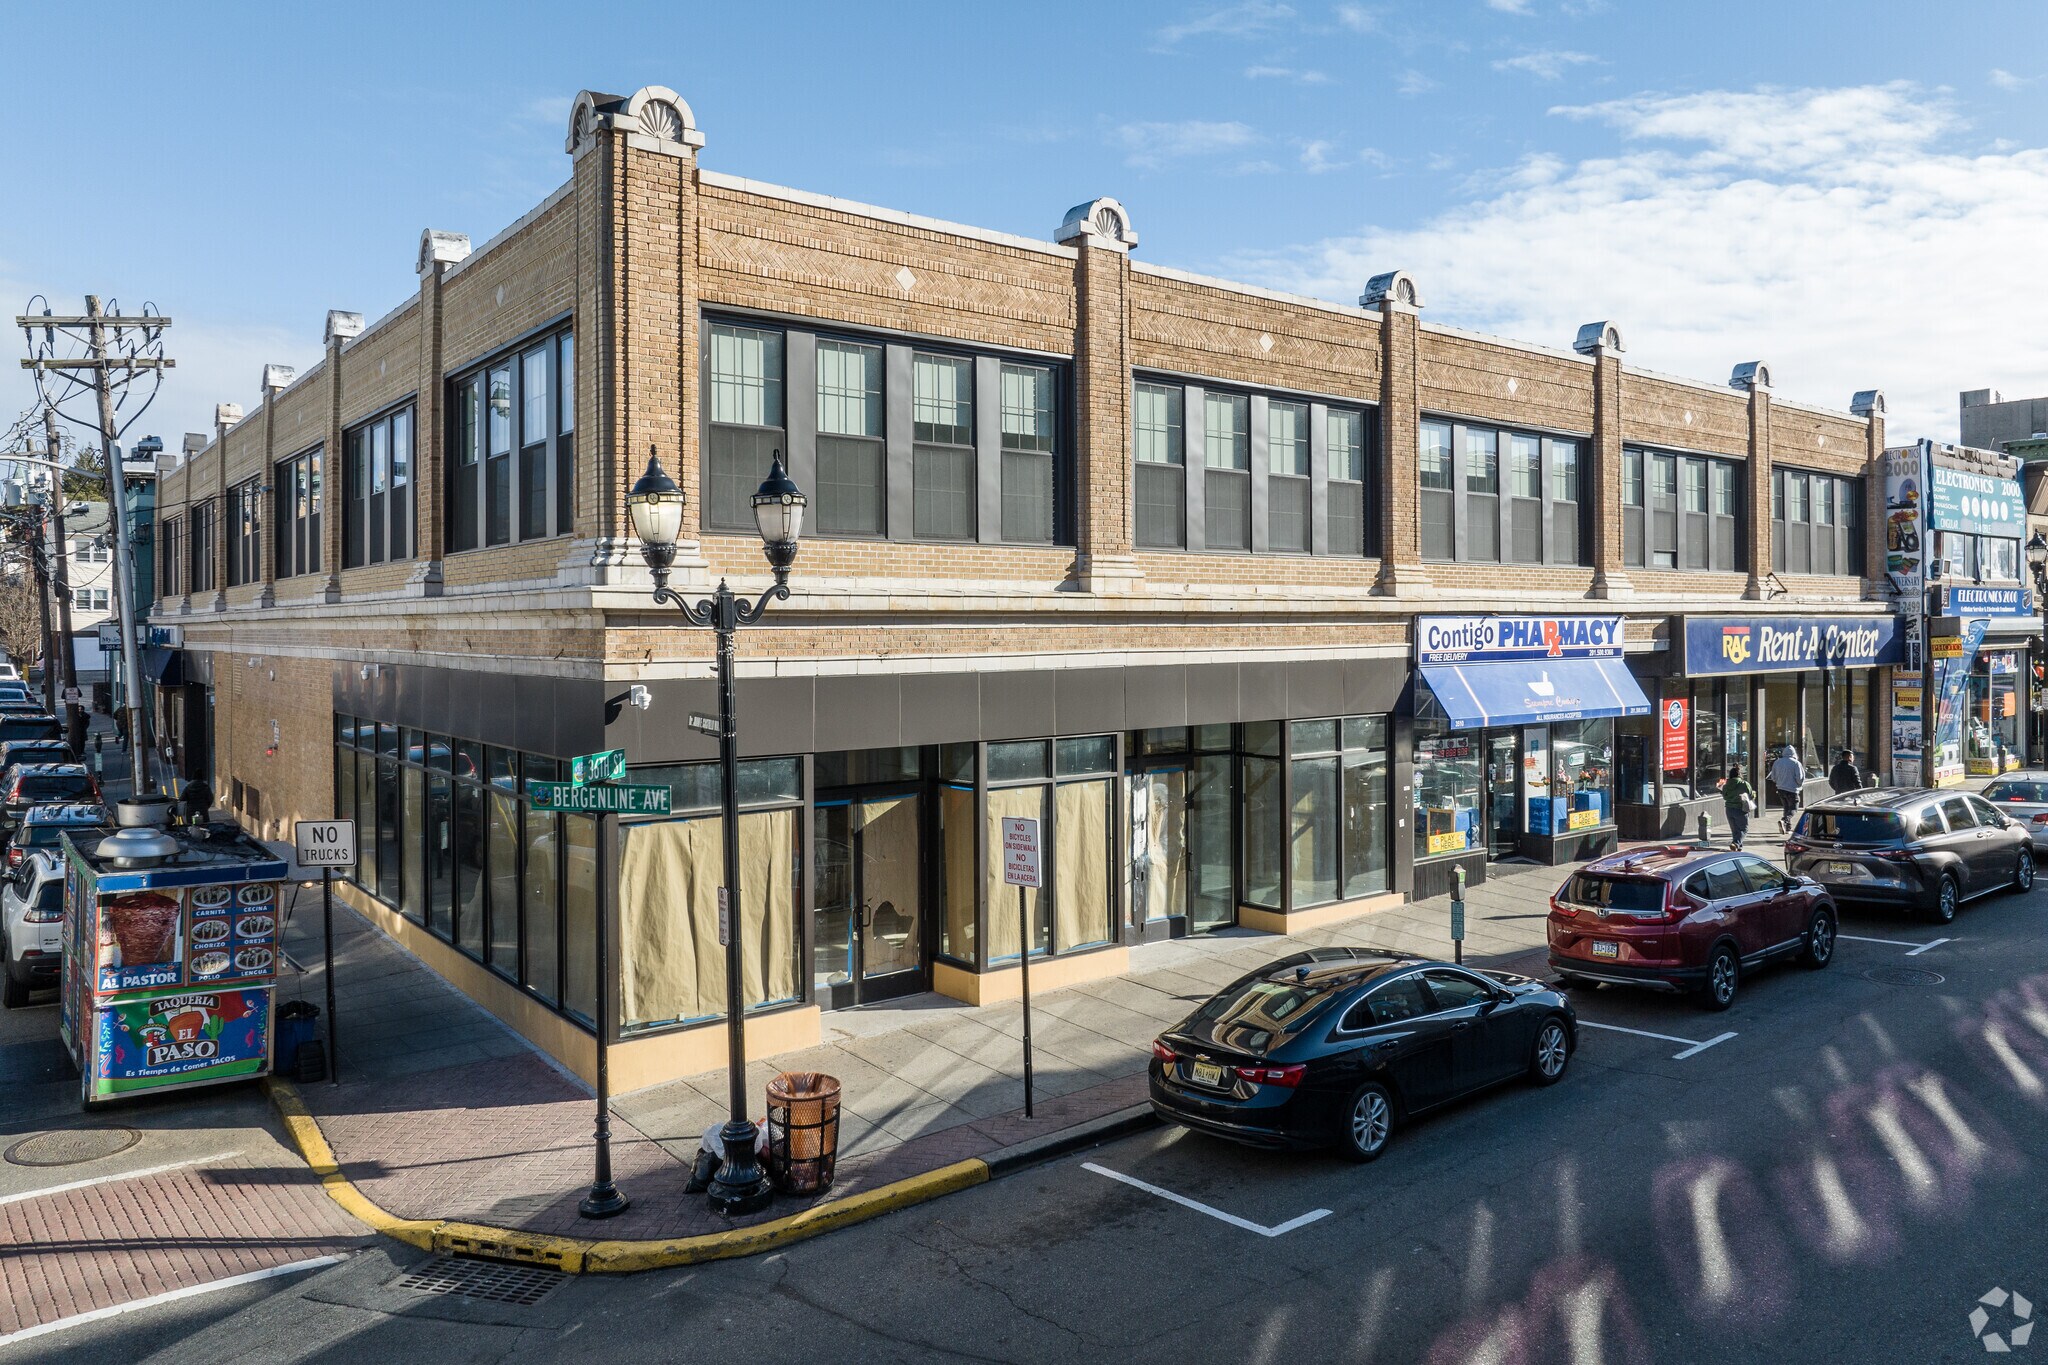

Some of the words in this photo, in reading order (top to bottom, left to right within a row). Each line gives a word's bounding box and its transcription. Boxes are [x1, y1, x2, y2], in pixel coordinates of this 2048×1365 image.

[1886, 461, 1918, 476] 2000
[1936, 470, 1994, 494] ELECTRONICS
[2001, 481, 2020, 497] 2000
[1934, 502, 1959, 510] PANASONIC
[1958, 589, 2002, 603] ELECTRONICS
[1428, 621, 1494, 650] Contigo
[1498, 620, 1616, 656] PHARMACY
[1428, 653, 1443, 662] FREE
[1443, 652, 1468, 662] DELIVERY
[1722, 636, 1750, 664] RAC
[588, 756, 610, 780] 36TH
[613, 753, 623, 775] ST
[553, 786, 636, 810] BERGENLINE
[643, 789, 668, 810] AVE
[312, 826, 338, 843] NO
[1009, 833, 1031, 842] BICYCLES
[1013, 843, 1036, 852] SIDEWALK
[1441, 841, 1454, 849] HERE
[304, 849, 348, 860] TRUCKS
[1009, 863, 1034, 872] BICICLETAS
[1021, 874, 1036, 882] ACERA
[101, 978, 119, 990] AL
[123, 972, 176, 987] PASTOR
[155, 996, 214, 1011] TAQUERIA
[178, 1028, 195, 1040] EL
[153, 1041, 216, 1064] PASO
[139, 1068, 168, 1077] Tiempo
[183, 1062, 208, 1071] Comer
[211, 1055, 236, 1065] TACOS
